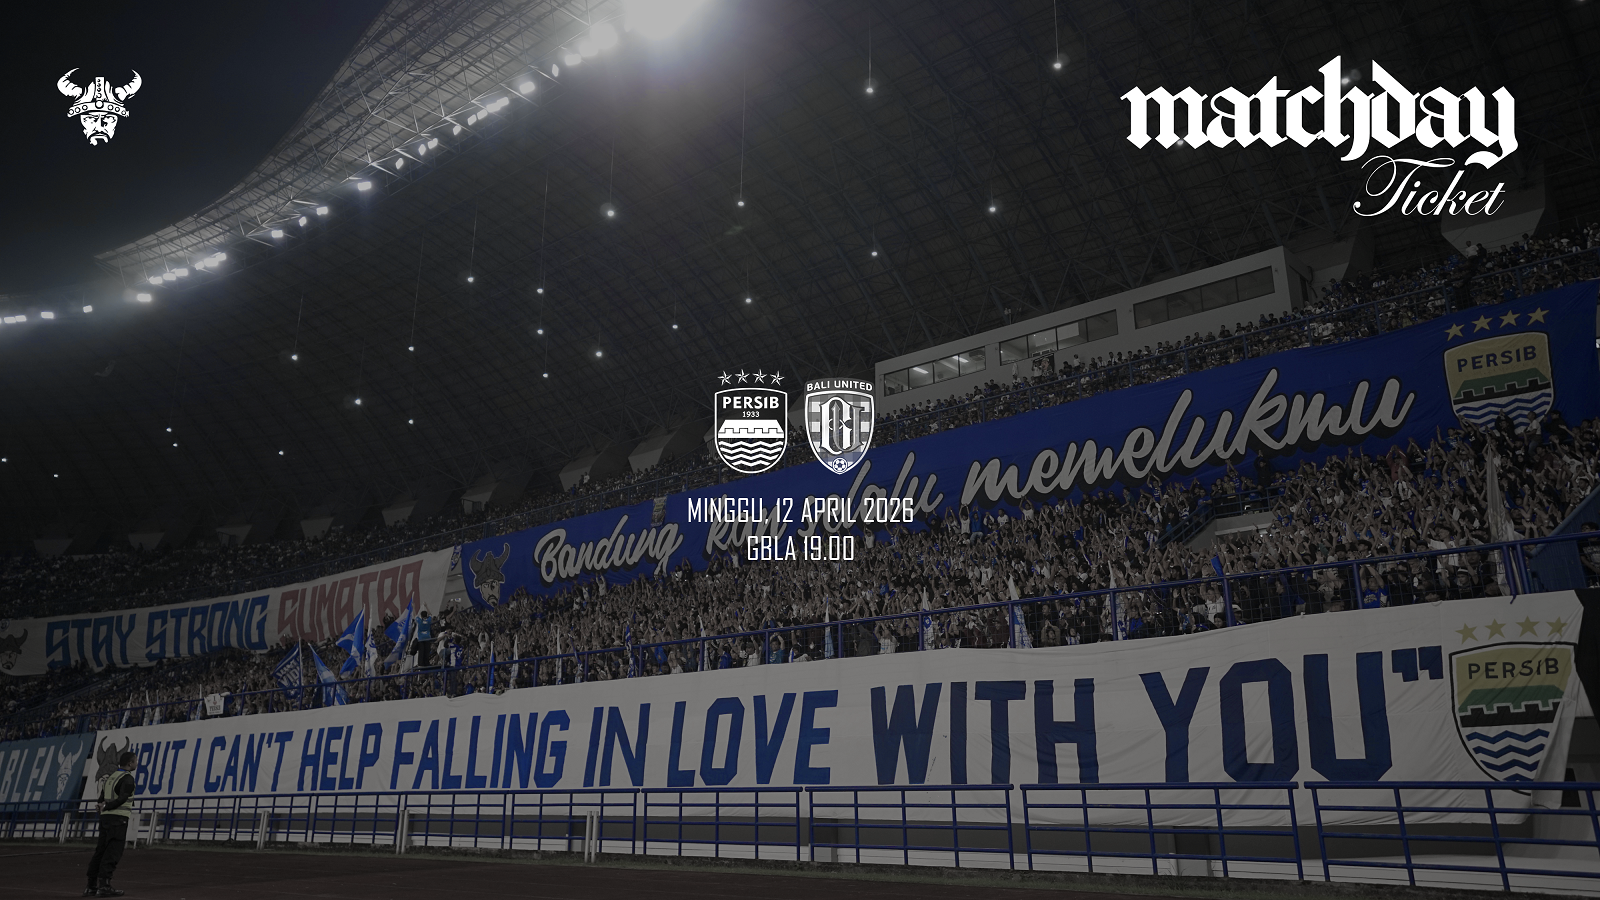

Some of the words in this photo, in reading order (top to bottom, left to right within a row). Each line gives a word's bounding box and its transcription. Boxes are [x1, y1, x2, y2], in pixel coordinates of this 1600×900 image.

[1457, 345, 1538, 372] PERSIB
[535, 514, 683, 582] Bandung
[961, 368, 1417, 502] memelukmu
[46, 615, 136, 671] STAY
[146, 597, 269, 661] STRONG
[278, 561, 423, 643] SUMATRA
[1467, 657, 1561, 681] PERSIB
[186, 738, 202, 793] I
[203, 731, 294, 793] CAN'T
[298, 723, 382, 791] HELP
[391, 710, 570, 789] FALLING
[583, 703, 650, 787] IN
[667, 689, 839, 787] LOVE
[870, 679, 1099, 785] WITH
